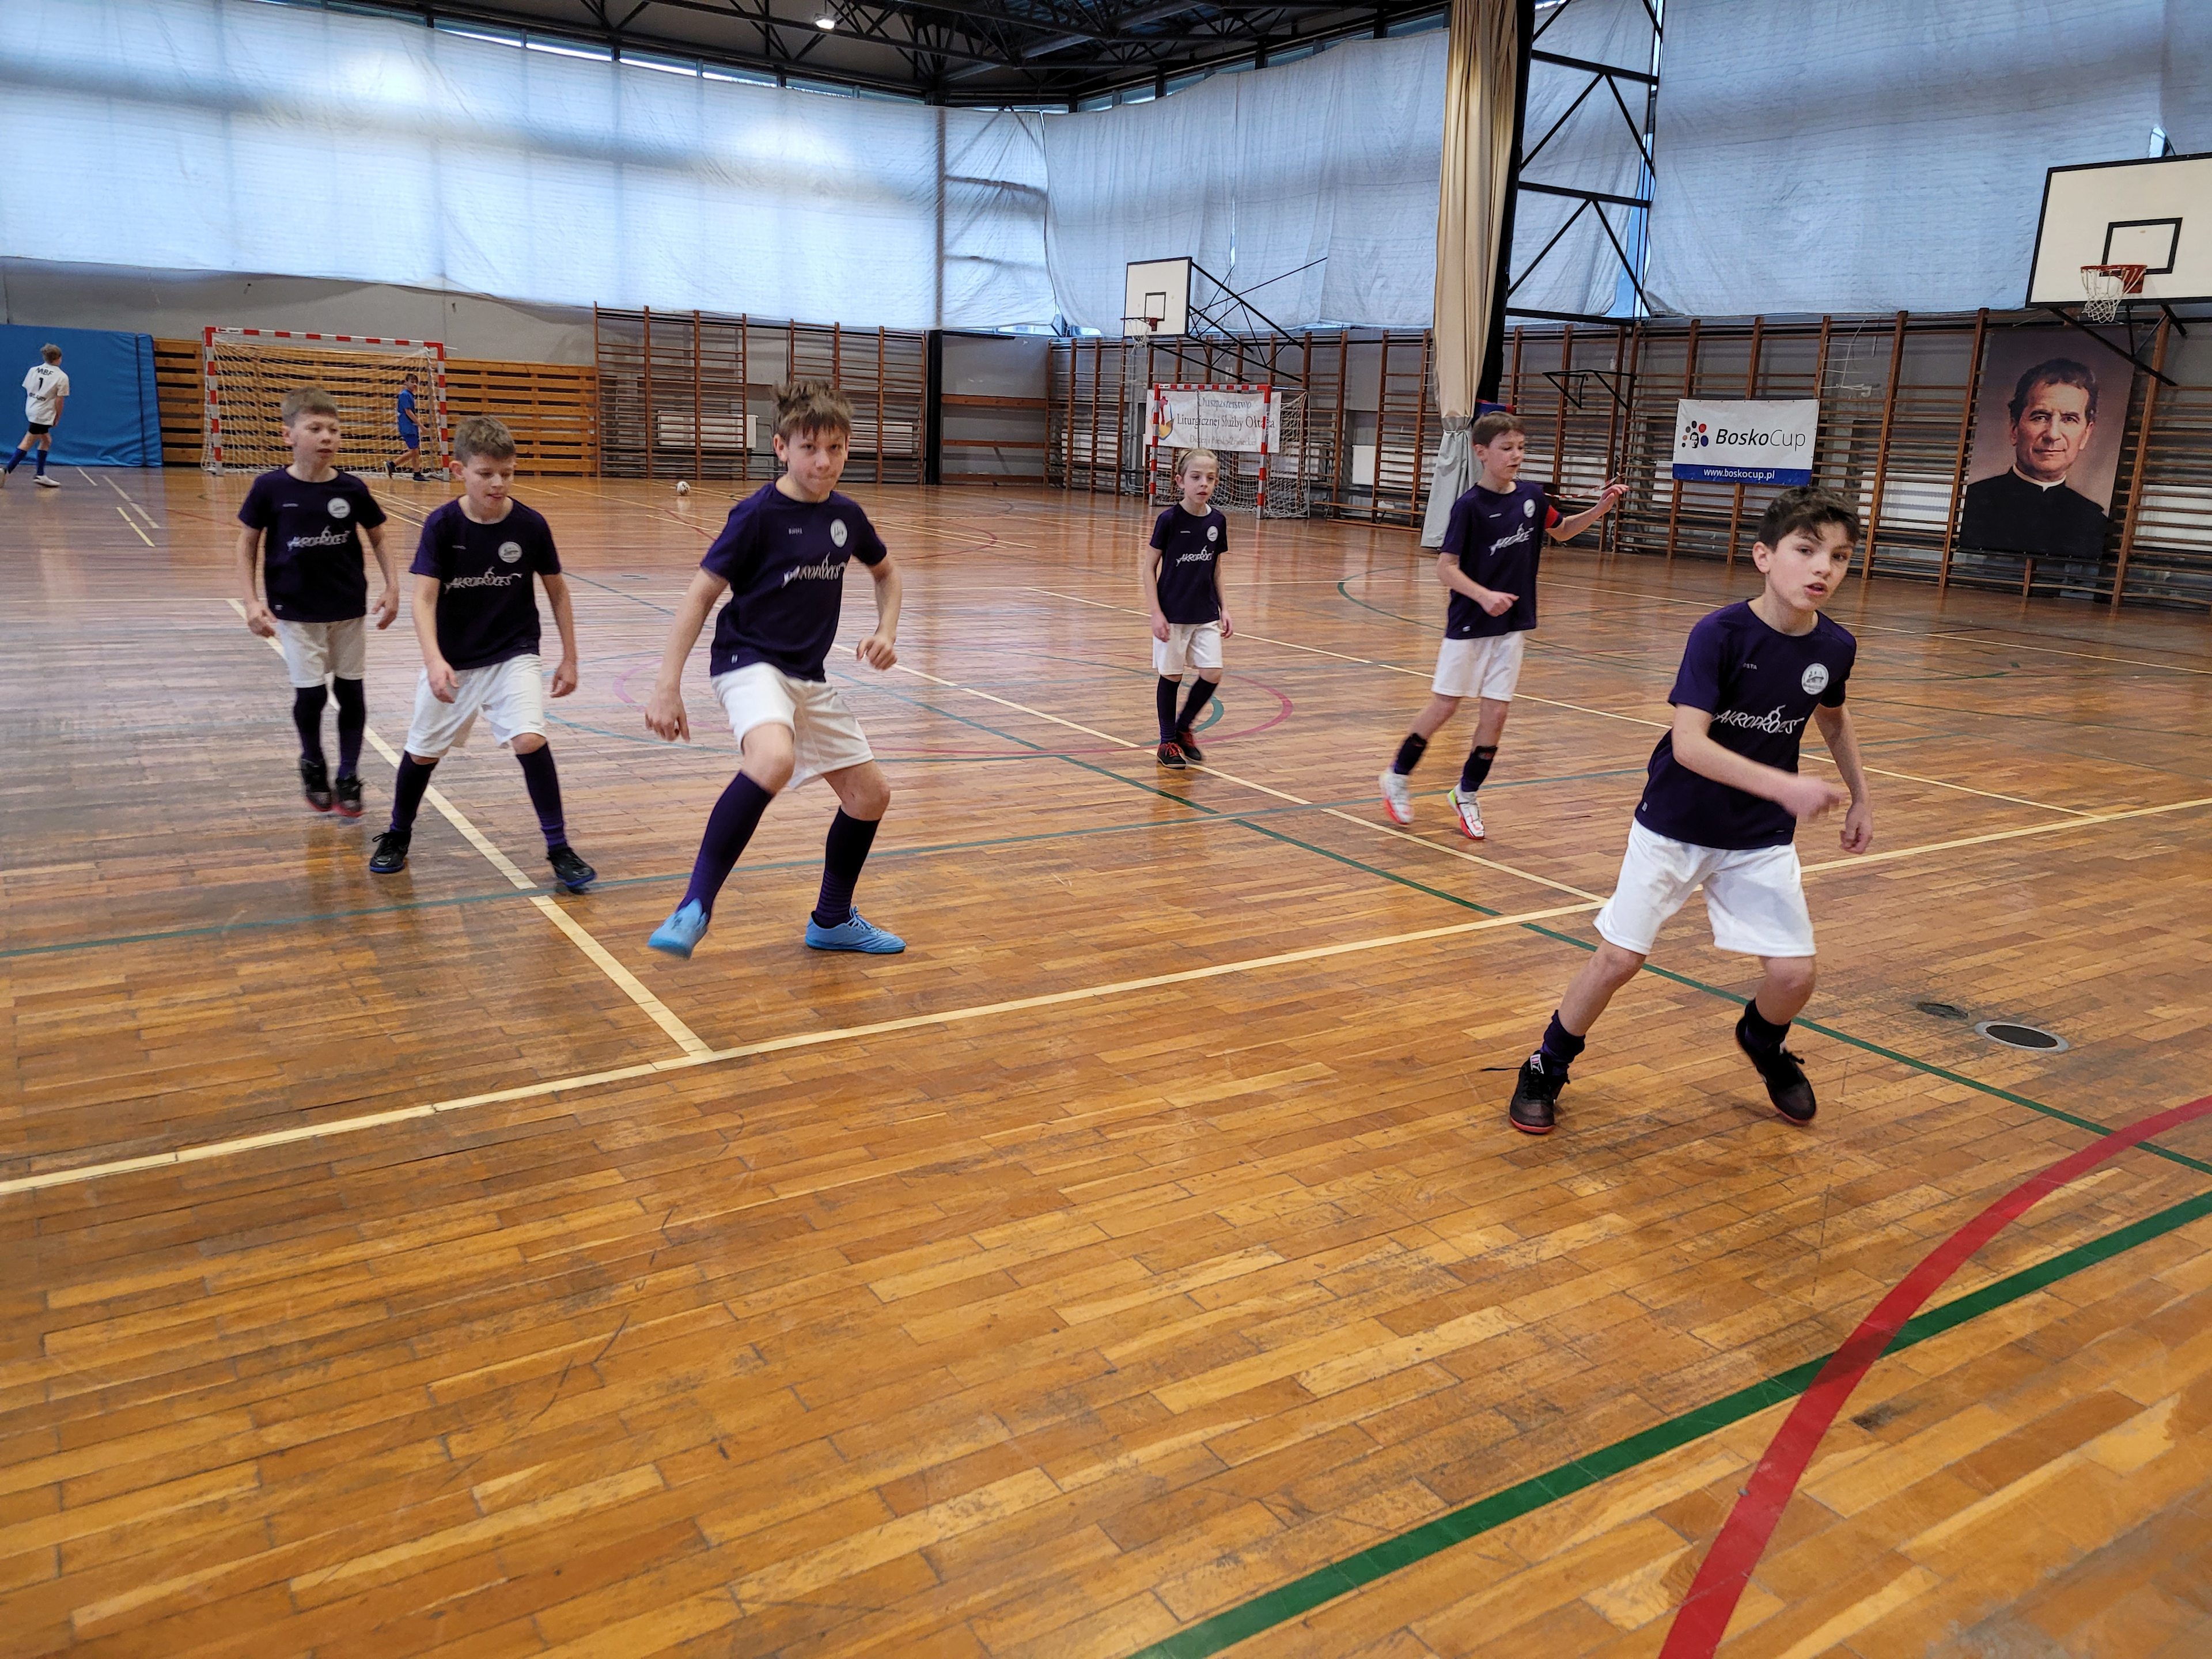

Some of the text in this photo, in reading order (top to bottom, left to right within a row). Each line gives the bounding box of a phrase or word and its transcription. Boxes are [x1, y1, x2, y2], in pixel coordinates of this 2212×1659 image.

[36, 367, 54, 376] MBF
[39, 377, 44, 391] 1
[1177, 413, 1219, 429] Liturgicznej
[1221, 414, 1243, 431] Służby
[1246, 415, 1275, 428] Ołta
[1715, 429, 1806, 452] BoskoCup
[1703, 468, 1775, 480] www.boskocup.pl
